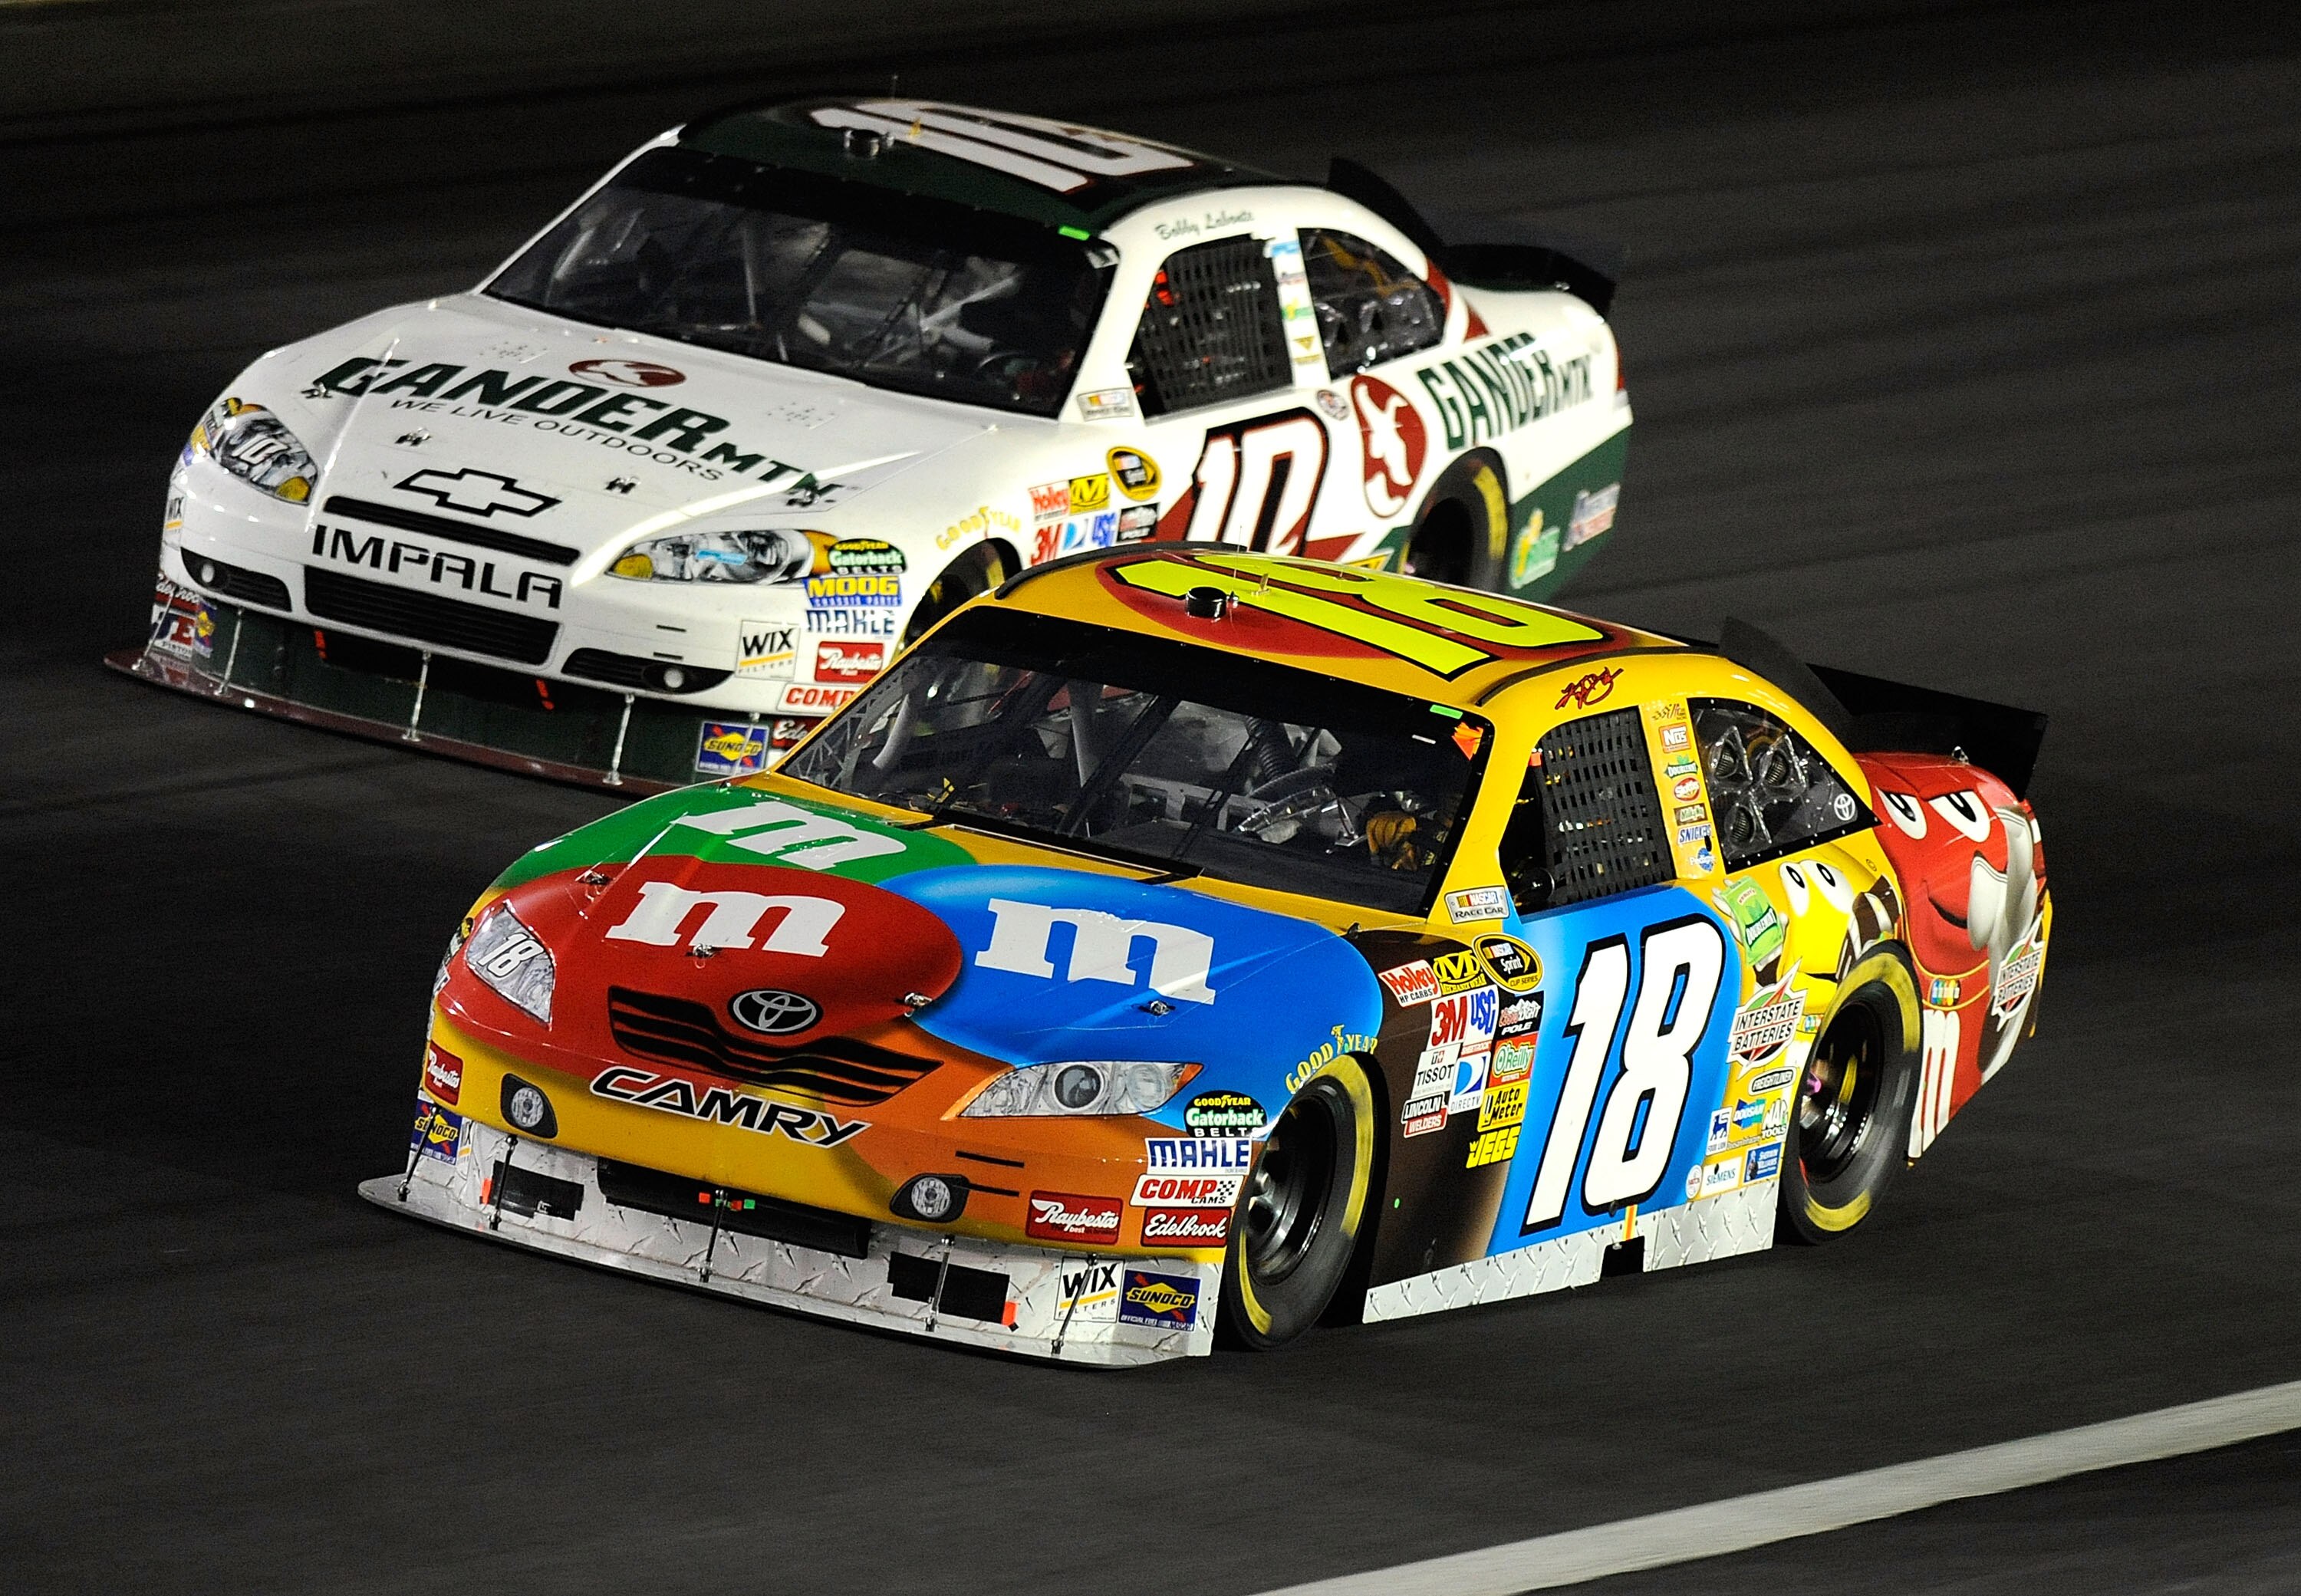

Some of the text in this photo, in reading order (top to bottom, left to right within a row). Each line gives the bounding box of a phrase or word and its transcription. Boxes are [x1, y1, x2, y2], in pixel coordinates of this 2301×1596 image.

[809, 98, 1195, 194] 10
[1417, 333, 1557, 451] GANDER
[311, 357, 844, 503] GANDER MTN
[390, 399, 724, 482] WE LIVE OUTDOORS
[1186, 408, 1328, 554] 10
[312, 524, 563, 609] IMPALA
[808, 577, 899, 598] MOOG
[1112, 553, 1608, 679] 18
[742, 627, 794, 657] WIX
[739, 660, 793, 673] FILTERS
[707, 739, 760, 754] SUNOCO
[1679, 824, 1711, 843] SNICKERS
[605, 882, 845, 957] m
[1485, 907, 1505, 915] CAR
[476, 933, 545, 977] 18
[975, 898, 1216, 1005] m
[1500, 955, 1523, 975] Sprint
[1381, 966, 1438, 995] Holley
[1522, 976, 1539, 984] SERIES
[1399, 989, 1434, 1004] HP CARBS
[1431, 996, 1467, 1047] 3M
[1501, 1022, 1533, 1035] POLE
[1735, 1001, 1801, 1032] INTERSTATE
[1734, 1022, 1792, 1051] BATTERIES
[1285, 1024, 1378, 1094] GOODYEAR
[1496, 1044, 1533, 1073] O'Reilly
[1417, 1065, 1454, 1087] TISSOT
[1519, 913, 1725, 1236] 18
[590, 1067, 872, 1149] CAMRY
[1194, 1095, 1252, 1108] GOODYEAR
[1404, 1096, 1442, 1120] LINCOLN
[1450, 1095, 1481, 1113] DIRECTV
[1495, 1088, 1520, 1106] Auto
[1186, 1107, 1266, 1127] Gatorback
[1408, 1114, 1443, 1134] WELDERS
[1491, 1102, 1523, 1120] Meter
[1762, 1125, 1787, 1140] TOOLS
[1148, 1140, 1249, 1168] MAHLE
[1466, 1126, 1522, 1169] JEGS
[1139, 1180, 1218, 1199] COMP
[1707, 1168, 1736, 1186] SIEMENS
[1190, 1196, 1227, 1205] CAMS
[1031, 1199, 1119, 1232] Raybestos
[1144, 1213, 1226, 1239] Edelbrock
[1063, 1262, 1118, 1298] WIX
[1058, 1298, 1116, 1318] FLTERS
[1128, 1289, 1192, 1306] SUNOCO
